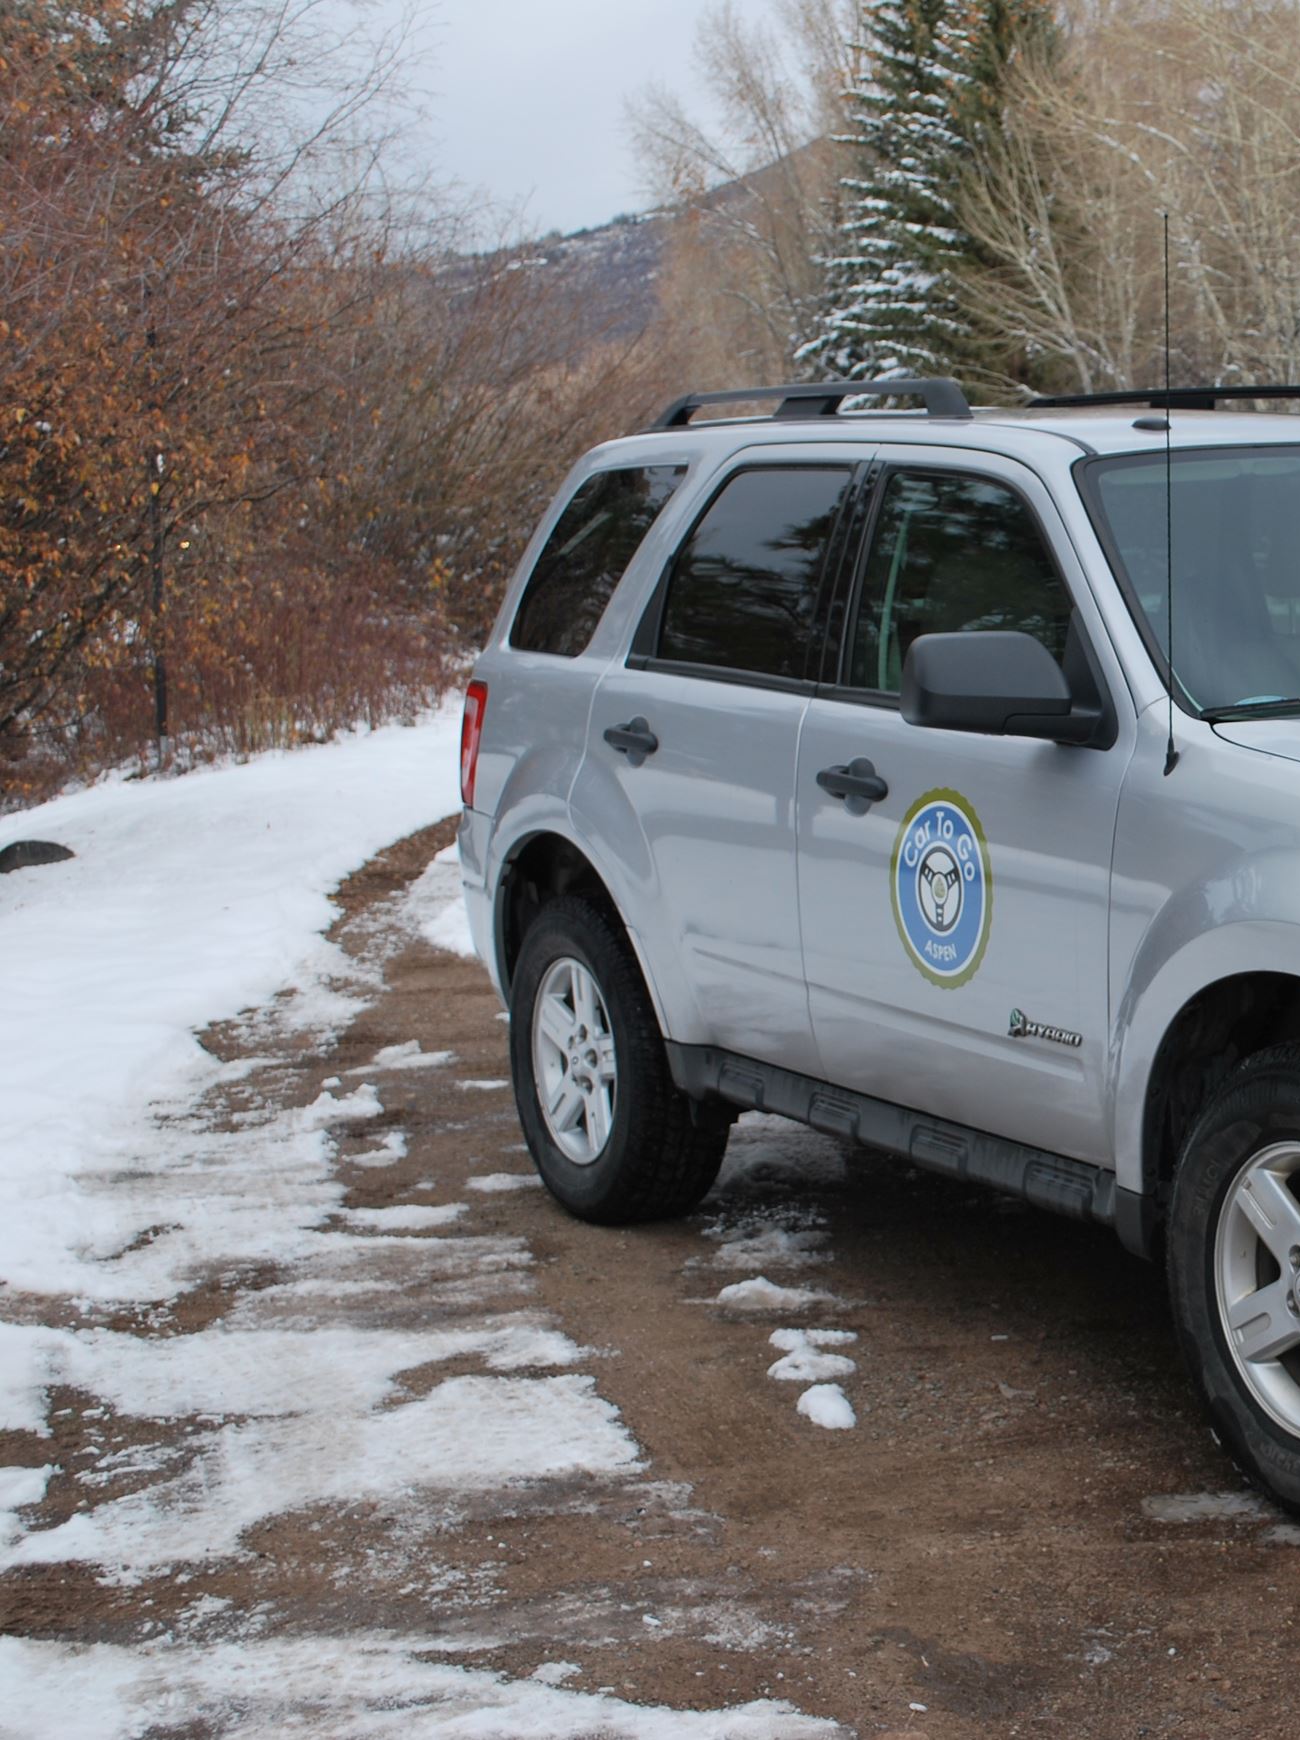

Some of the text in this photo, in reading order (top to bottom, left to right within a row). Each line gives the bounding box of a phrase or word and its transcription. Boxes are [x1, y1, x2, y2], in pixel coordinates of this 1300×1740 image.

[903, 811, 976, 882] Car To Go
[925, 939, 958, 962] ASPEN
